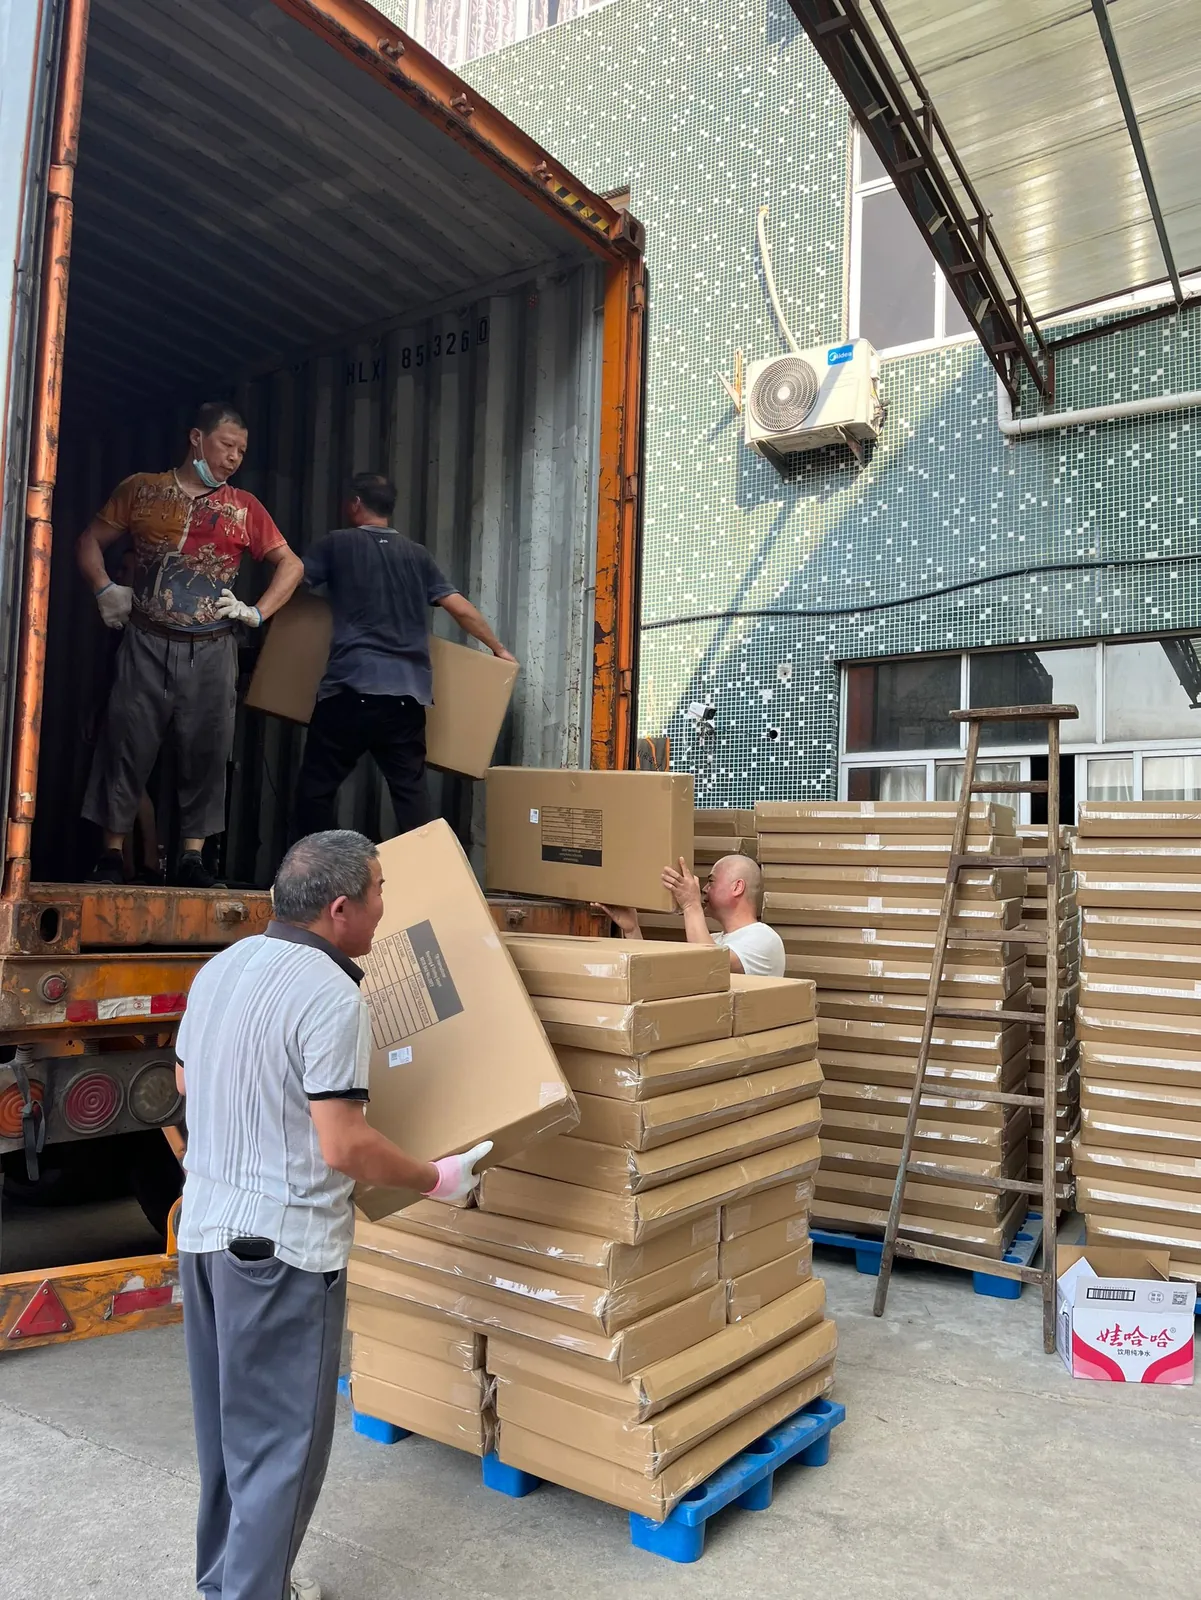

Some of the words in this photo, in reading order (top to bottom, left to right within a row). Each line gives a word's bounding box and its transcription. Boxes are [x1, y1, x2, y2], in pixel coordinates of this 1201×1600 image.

[1096, 1323, 1174, 1348] 娃哈哈
[1117, 1348, 1151, 1357] 饮用纯净水
